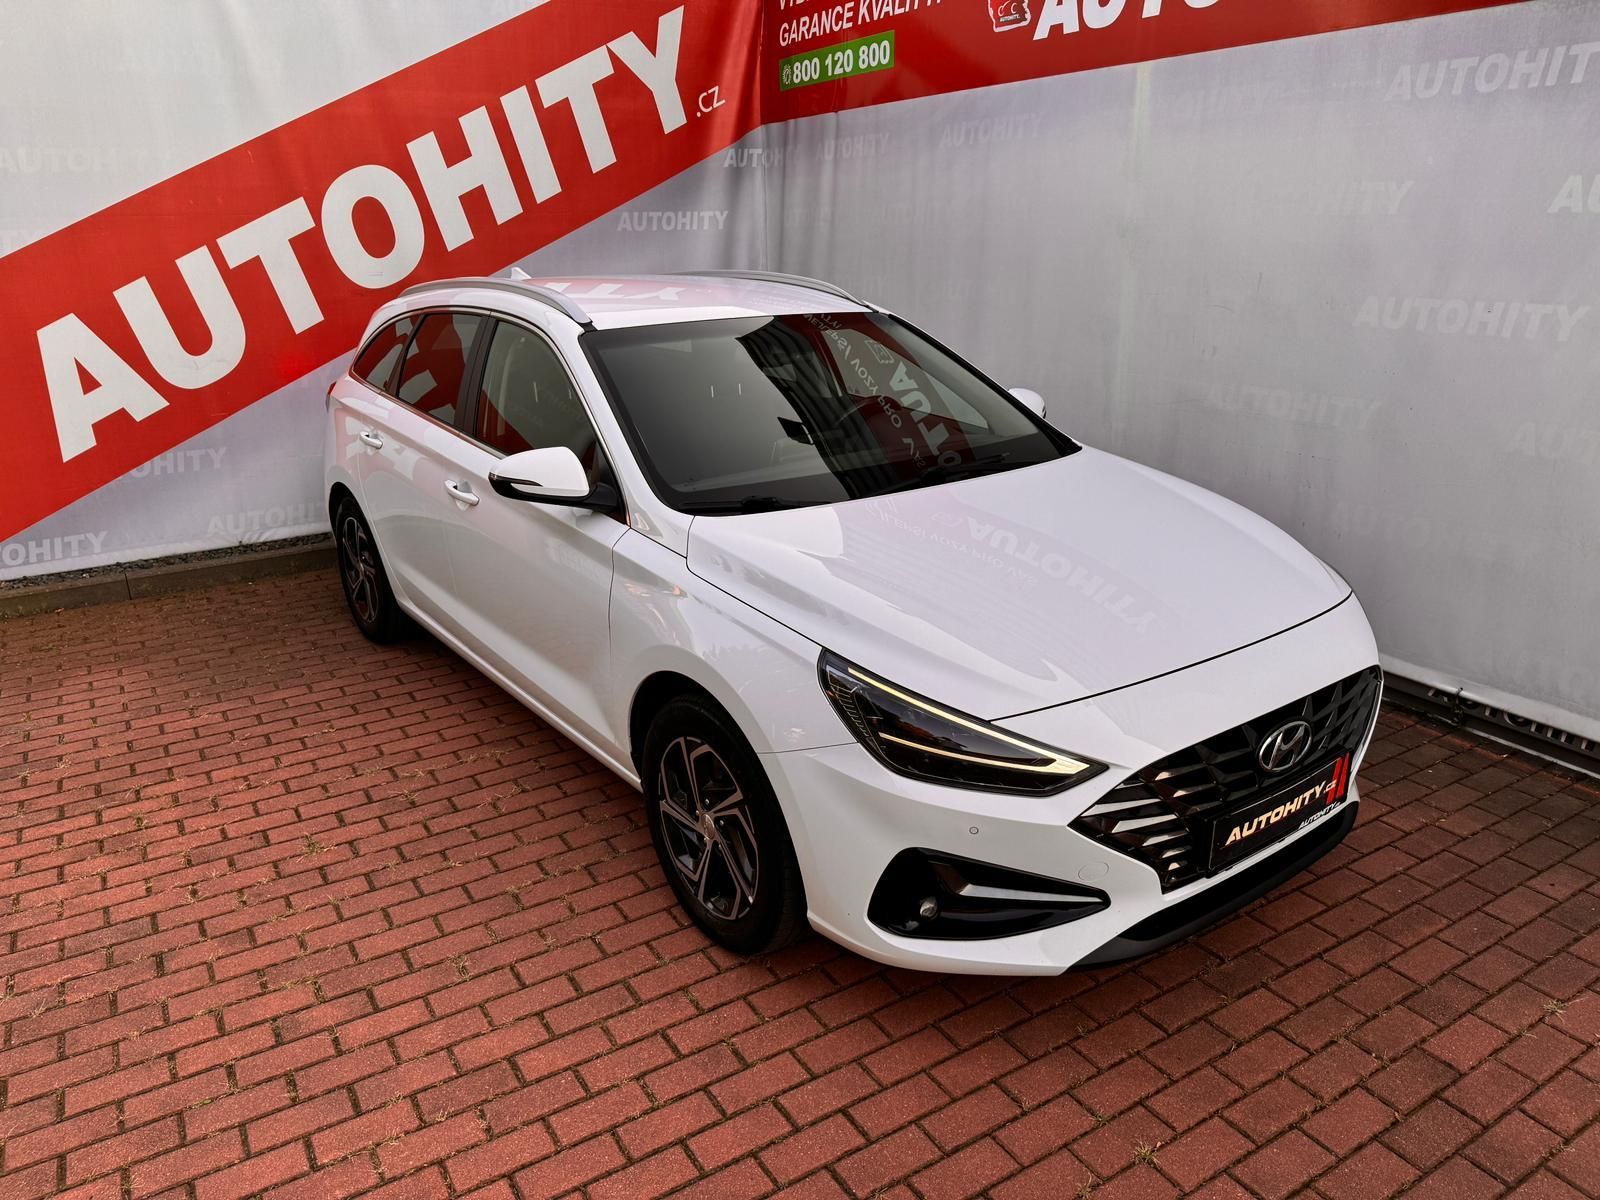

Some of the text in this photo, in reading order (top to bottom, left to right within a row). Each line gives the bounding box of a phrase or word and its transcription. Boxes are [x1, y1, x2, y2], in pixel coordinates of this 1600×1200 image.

[779, 0, 941, 47] GARANCE KVAL
[793, 40, 891, 84] 800 120 800
[36, 5, 687, 463] AUTOHITY
[616, 211, 729, 232] AUTOHITY
[1352, 296, 1592, 342] AUTOHITY
[0, 531, 108, 566] OHITY
